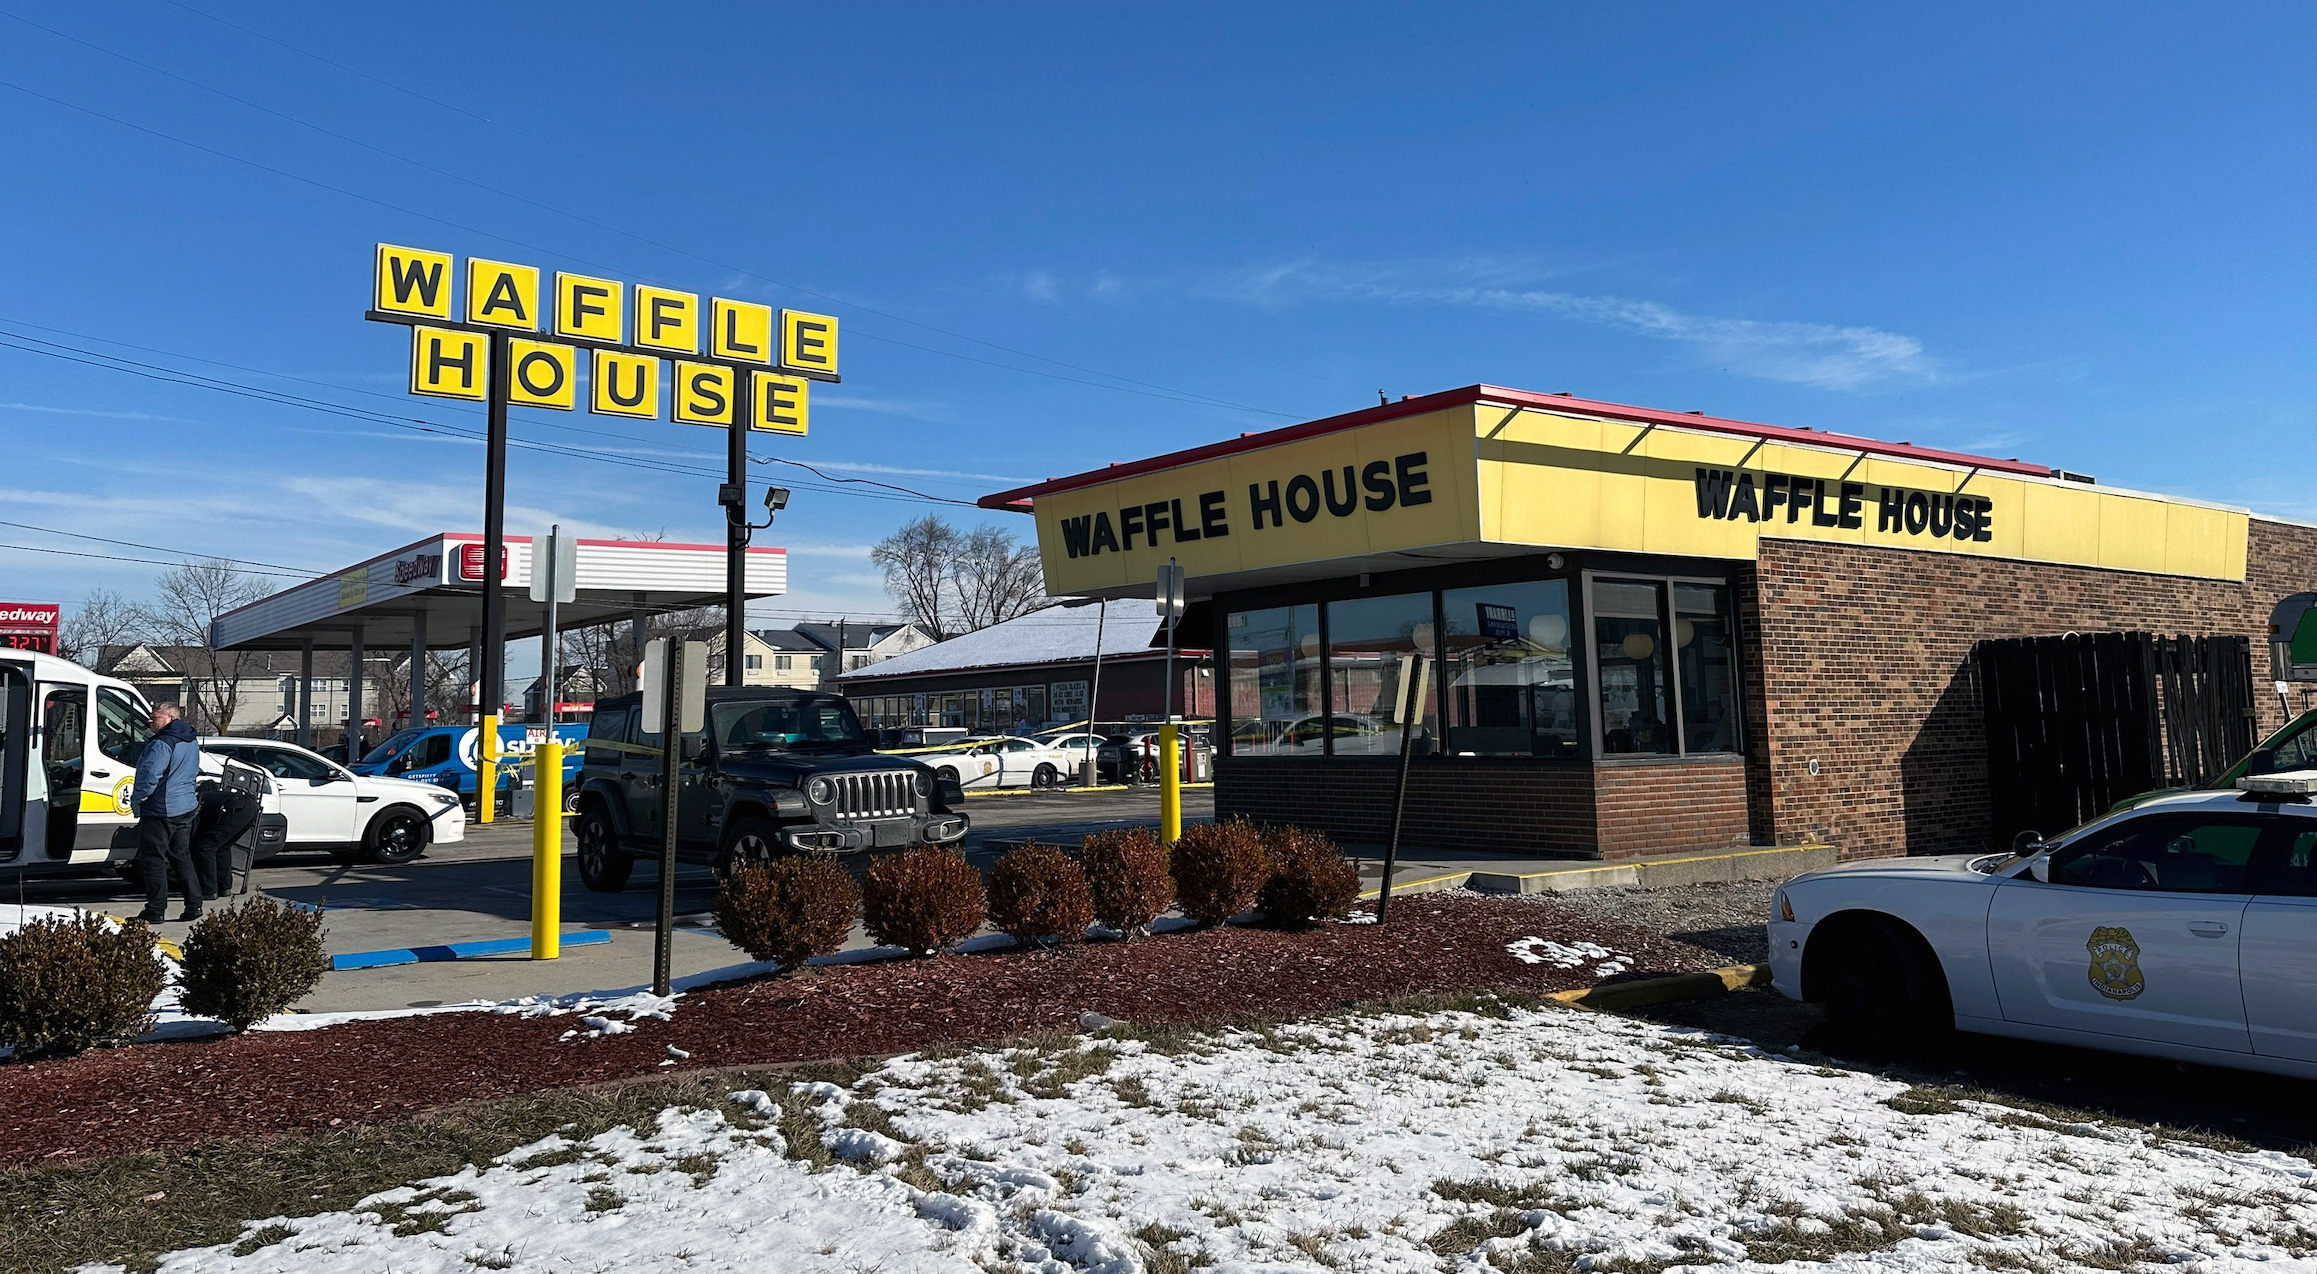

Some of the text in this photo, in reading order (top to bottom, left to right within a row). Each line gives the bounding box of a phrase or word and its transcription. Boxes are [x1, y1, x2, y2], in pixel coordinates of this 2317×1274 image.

[390, 256, 827, 363] WAFFLE
[429, 338, 798, 425] HOUSE
[1060, 451, 1433, 559] WAFFLE HOUSE
[1695, 467, 1993, 542] WAFFLE HOUSE
[527, 728, 547, 738] AIR
[2092, 978, 2142, 994] INDIANAPOLIS
[2098, 944, 2129, 954] POLICE
